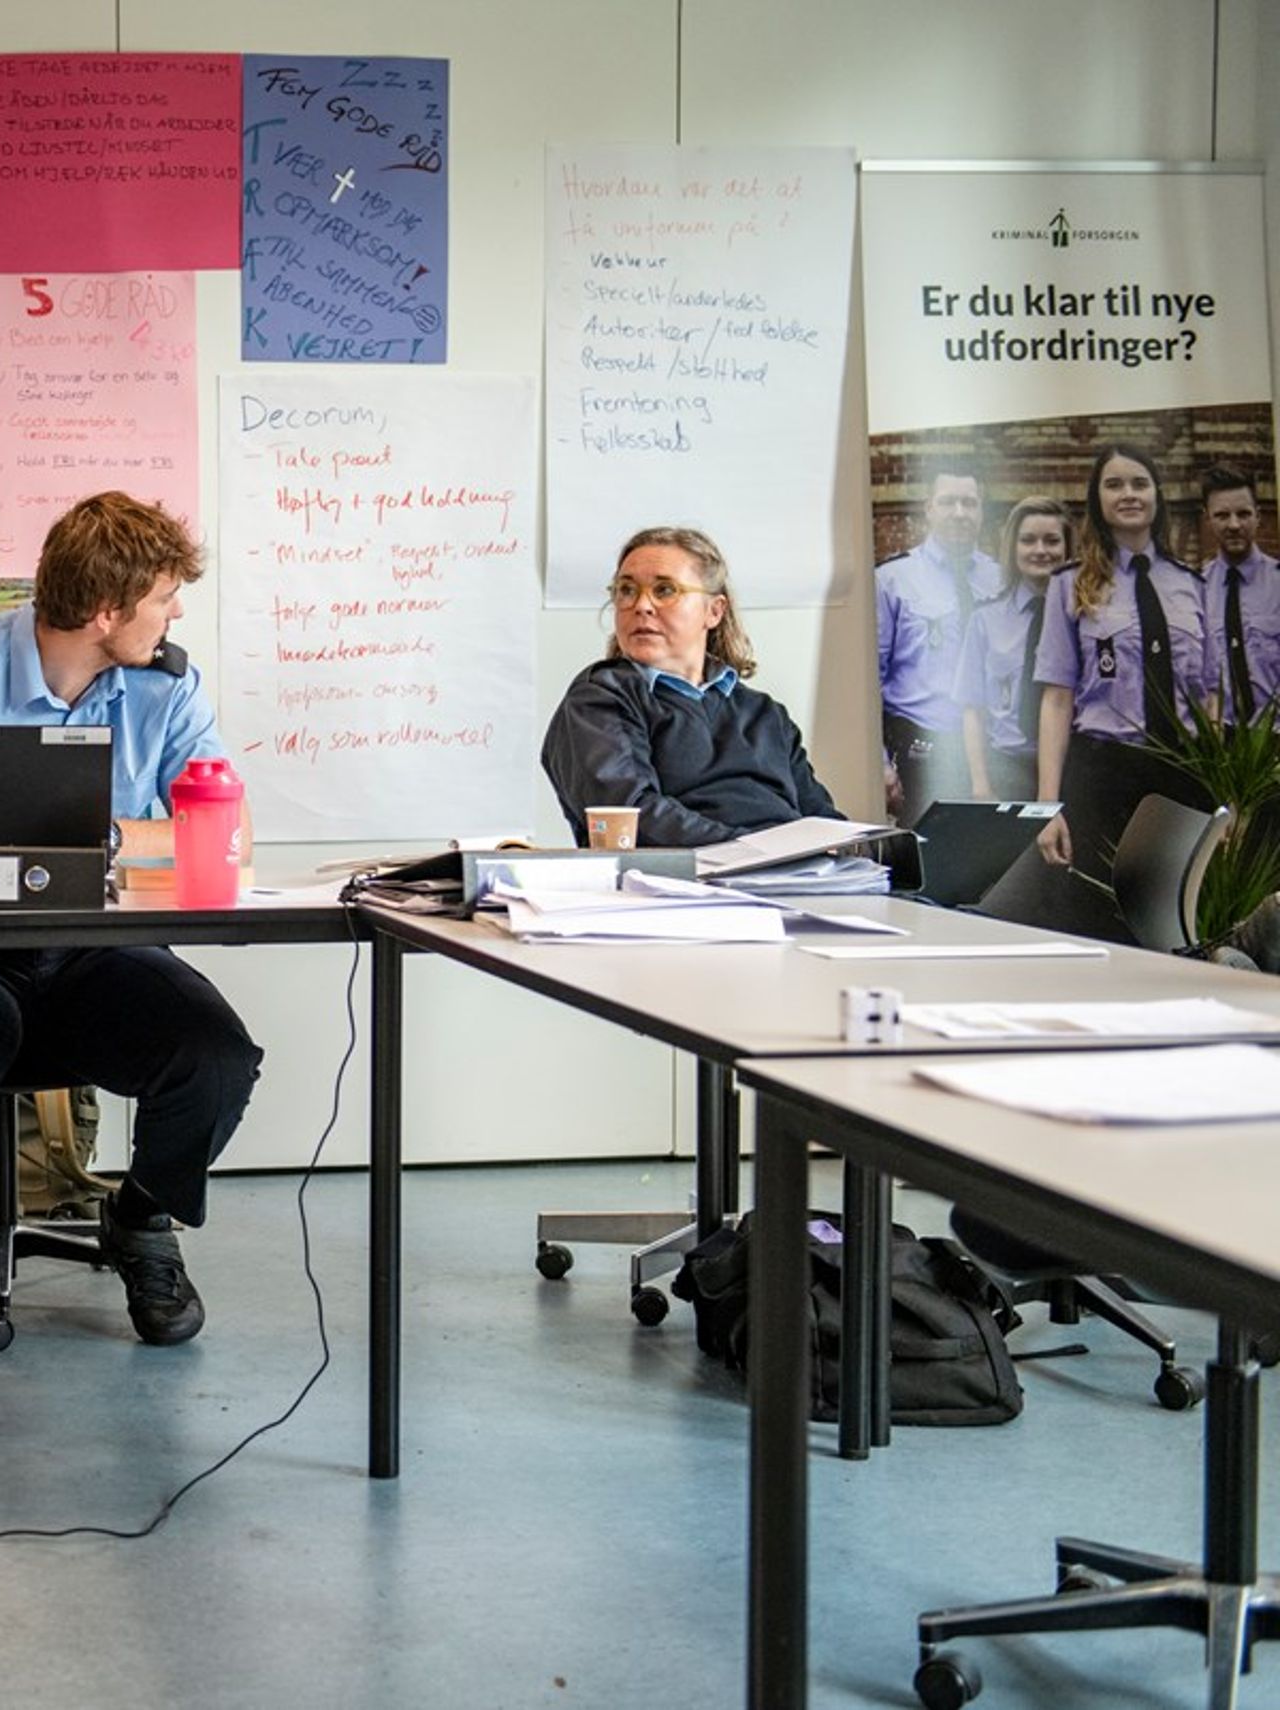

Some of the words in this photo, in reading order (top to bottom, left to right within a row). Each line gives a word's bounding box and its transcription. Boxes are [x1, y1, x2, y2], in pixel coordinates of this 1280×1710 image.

[22, 61, 72, 76] TAGE
[89, 112, 126, 131] NÅR
[129, 118, 151, 130] DU
[257, 68, 322, 110] FEM
[327, 97, 394, 137] GODE
[399, 133, 442, 174] RÅD
[0, 165, 28, 179] OM
[214, 167, 238, 180] UD
[273, 141, 325, 187] VÆR
[562, 163, 662, 200] Hvordan
[680, 181, 711, 201] var
[723, 175, 766, 197] det
[774, 174, 804, 200] at
[563, 208, 597, 246] få
[991, 230, 1048, 240] KRIMINAL
[1072, 230, 1140, 240] FORSORGEN
[22, 278, 54, 317] 5
[59, 281, 119, 319] GODE
[128, 275, 177, 320] RÅD
[263, 265, 373, 336] ÅBENHED
[316, 259, 418, 314] SAMMEN
[922, 285, 960, 318] Er
[969, 285, 1014, 318] du
[1024, 284, 1096, 317] klar
[1103, 285, 1142, 317] til
[1151, 292, 1217, 324] nye
[945, 329, 1197, 368] udfordringer?
[15, 363, 40, 388] Tag
[89, 368, 107, 383] for
[241, 395, 388, 434] Decorum,
[375, 487, 413, 527] god
[332, 730, 374, 752] som
